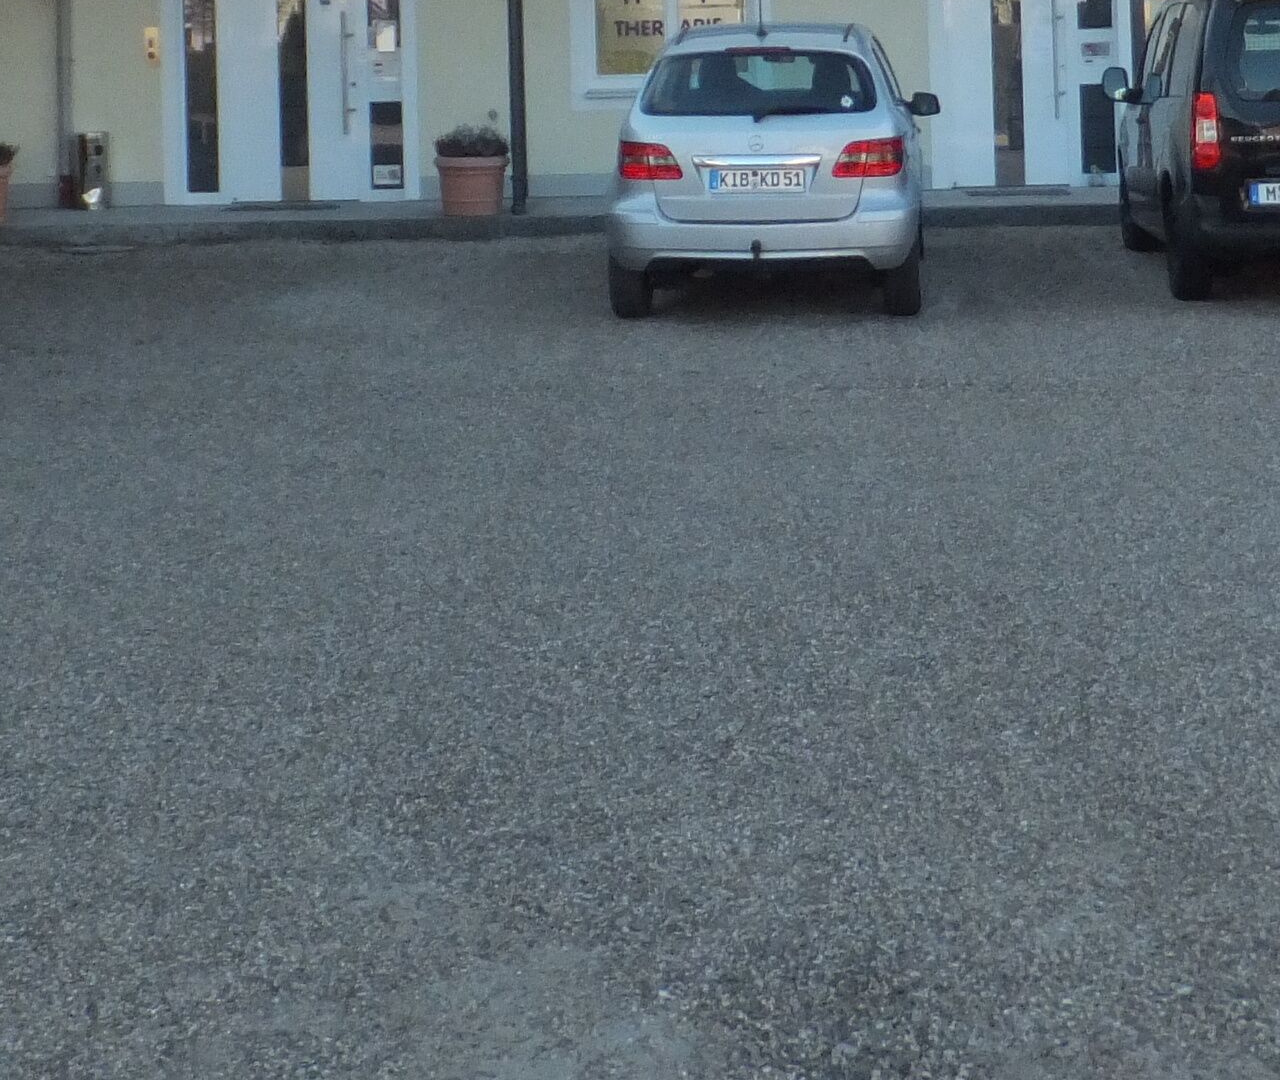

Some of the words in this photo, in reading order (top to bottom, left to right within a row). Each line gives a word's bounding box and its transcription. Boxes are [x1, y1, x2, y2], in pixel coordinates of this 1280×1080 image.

[720, 172, 750, 188] KIB
[760, 171, 780, 187] KD
[783, 171, 803, 187] 51
[1266, 186, 1277, 201] M
